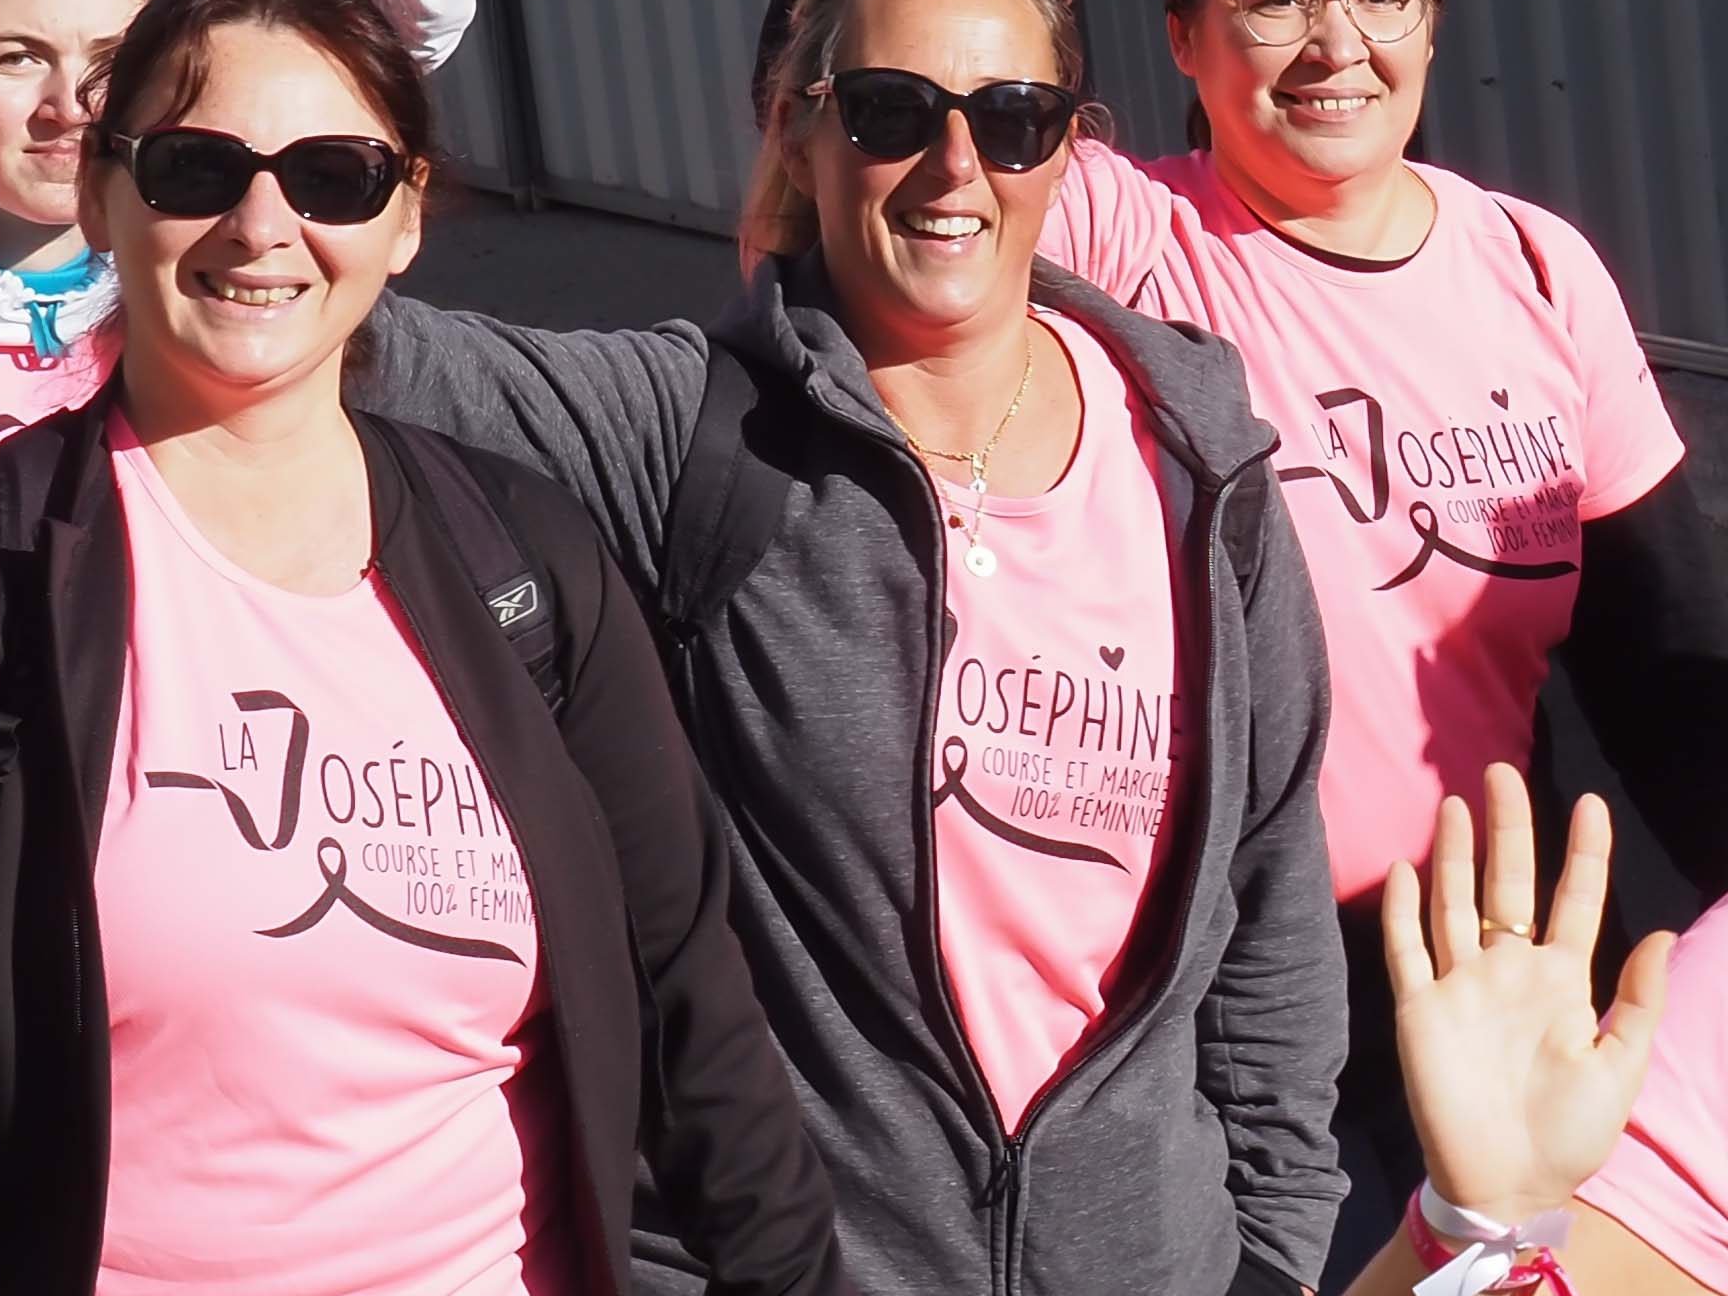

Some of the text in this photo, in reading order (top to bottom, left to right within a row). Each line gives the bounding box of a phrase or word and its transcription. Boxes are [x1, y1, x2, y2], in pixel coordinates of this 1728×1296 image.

[1278, 387, 1572, 524] LA JOSÉPHINE
[1446, 497, 1509, 524] COURSE
[1512, 494, 1531, 520] ET
[1486, 527, 1529, 555] 100%
[957, 654, 1182, 762] OSÉPHINE
[218, 722, 258, 772] LA
[982, 745, 1169, 805] COURSE ET MARCHE
[1010, 788, 1165, 839] 100% FÉMININE
[362, 842, 442, 878] COURSE
[455, 849, 477, 880] ET
[406, 881, 534, 925] 100% FÉMIN
